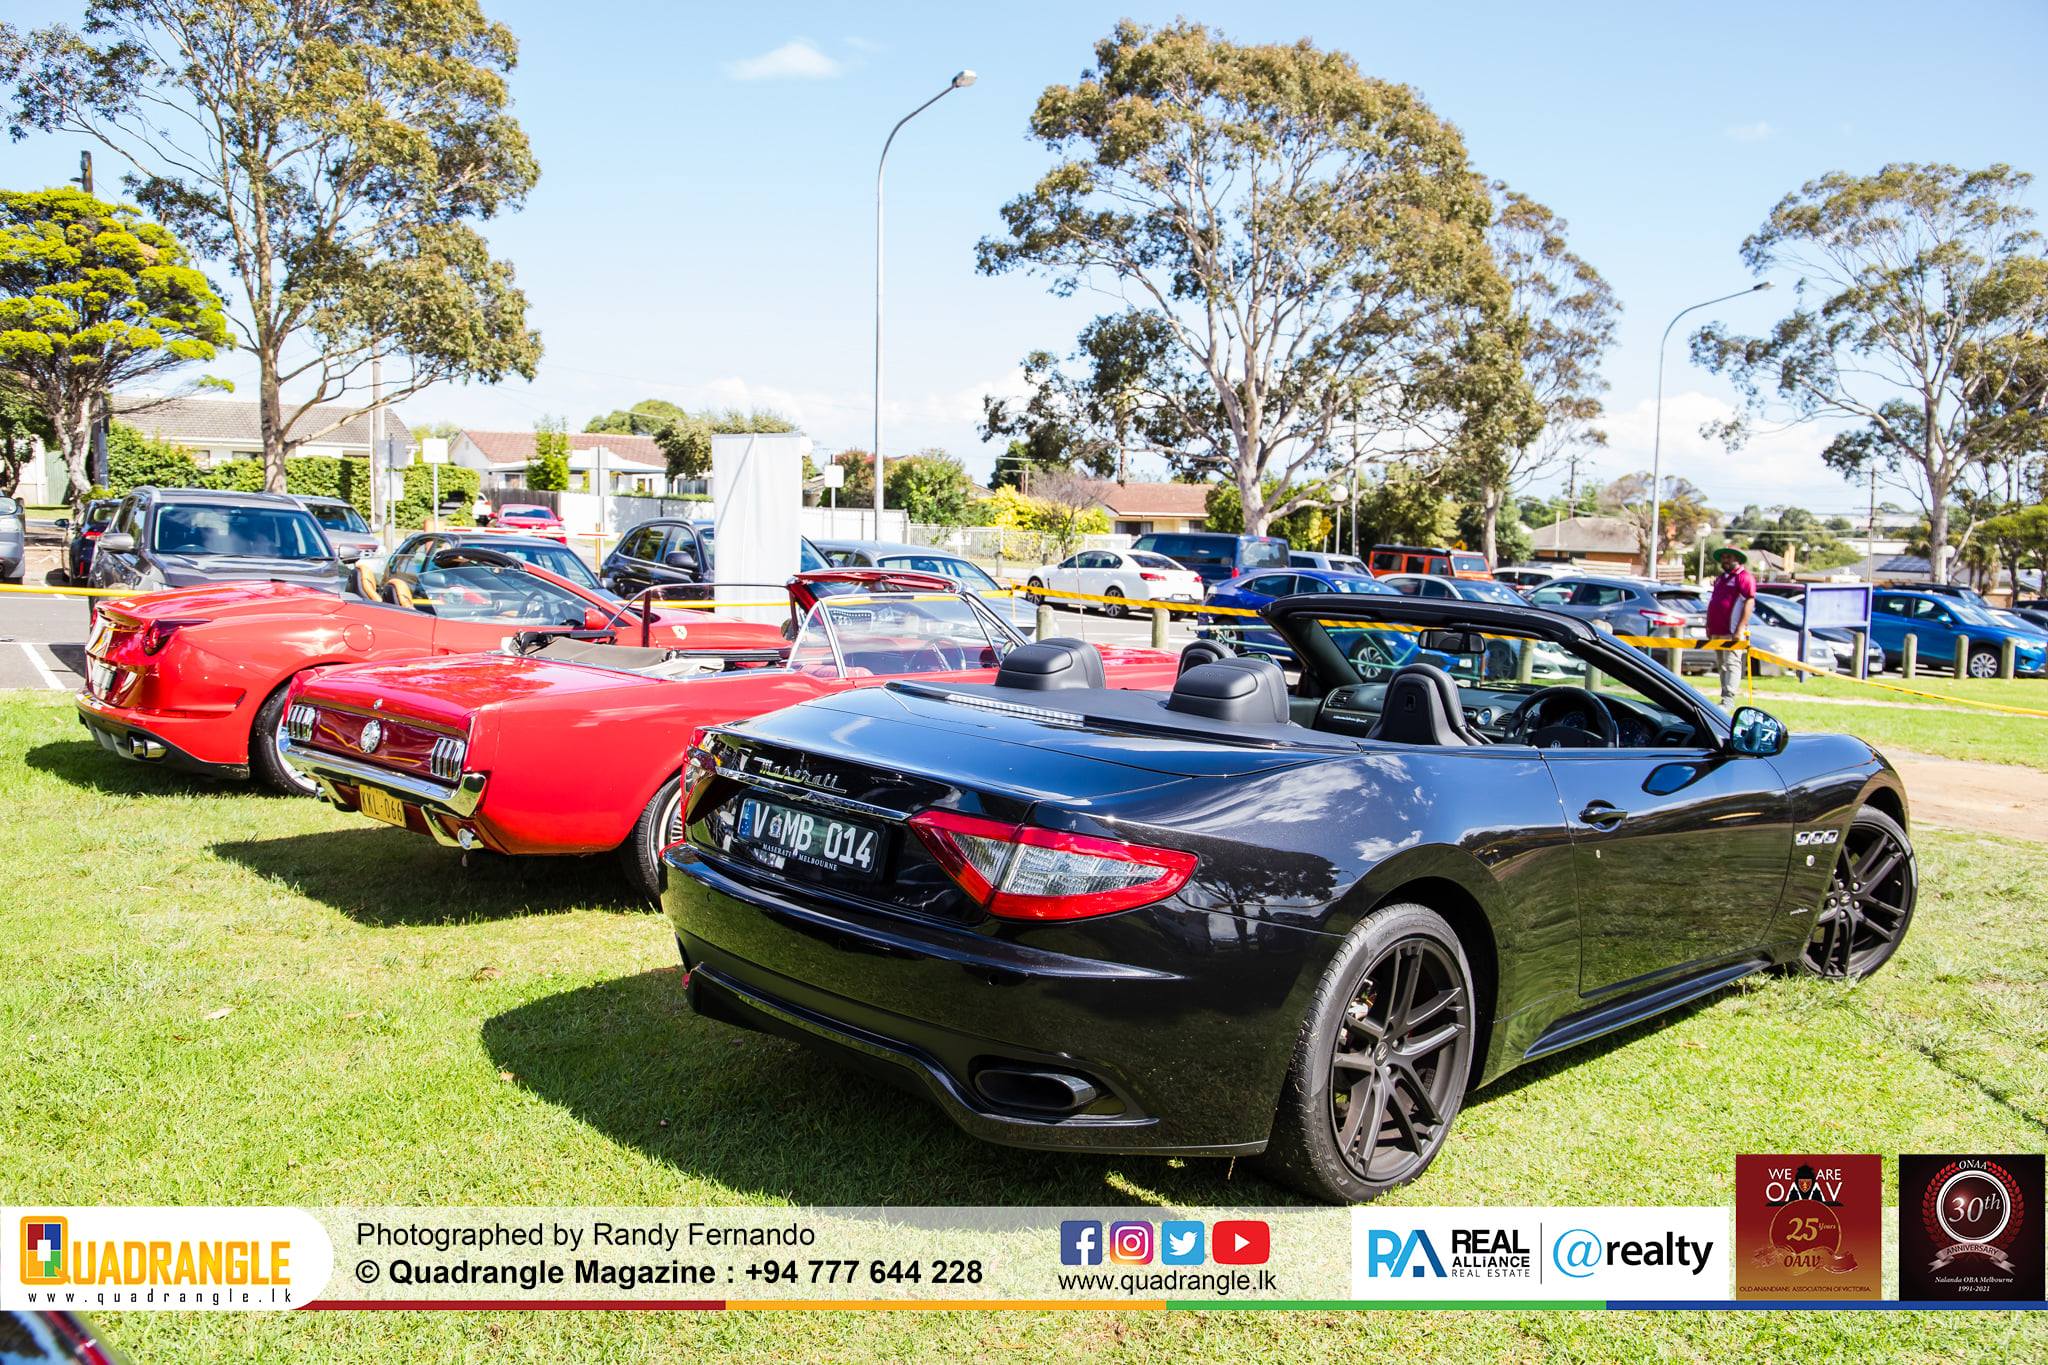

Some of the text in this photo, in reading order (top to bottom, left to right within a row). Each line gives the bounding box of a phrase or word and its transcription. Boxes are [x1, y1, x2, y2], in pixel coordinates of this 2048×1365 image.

[762, 843, 838, 871] MASERATI MELBOURNE
[824, 822, 874, 868] 014
